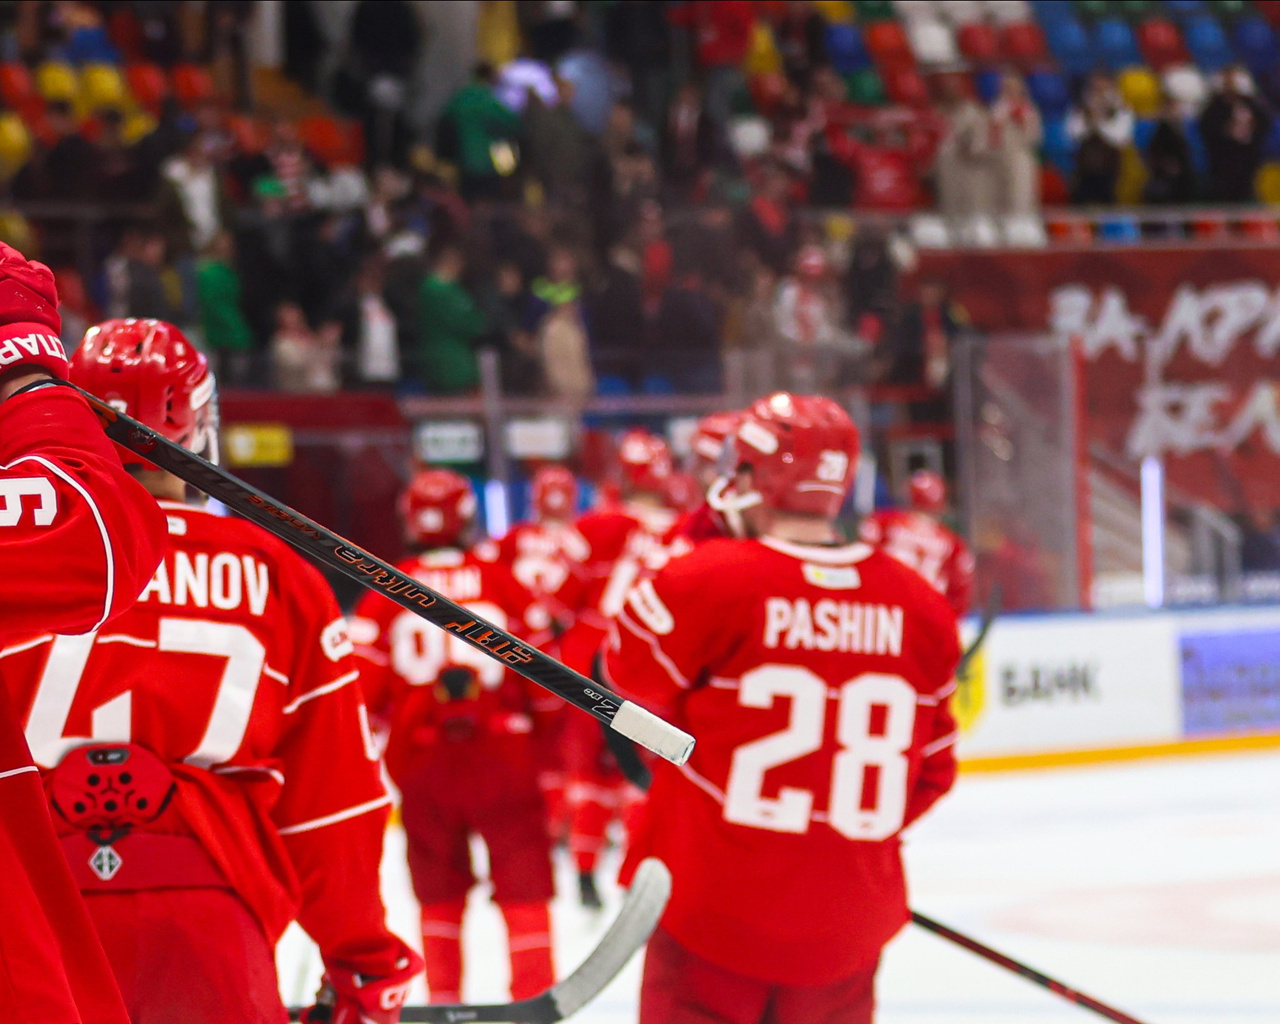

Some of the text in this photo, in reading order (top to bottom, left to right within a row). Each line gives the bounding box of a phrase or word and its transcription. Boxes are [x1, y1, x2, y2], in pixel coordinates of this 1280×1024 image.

[333, 545, 437, 608] ultra
[763, 596, 904, 657] PASHIN
[24, 616, 266, 769] 47
[722, 662, 918, 842] 28
